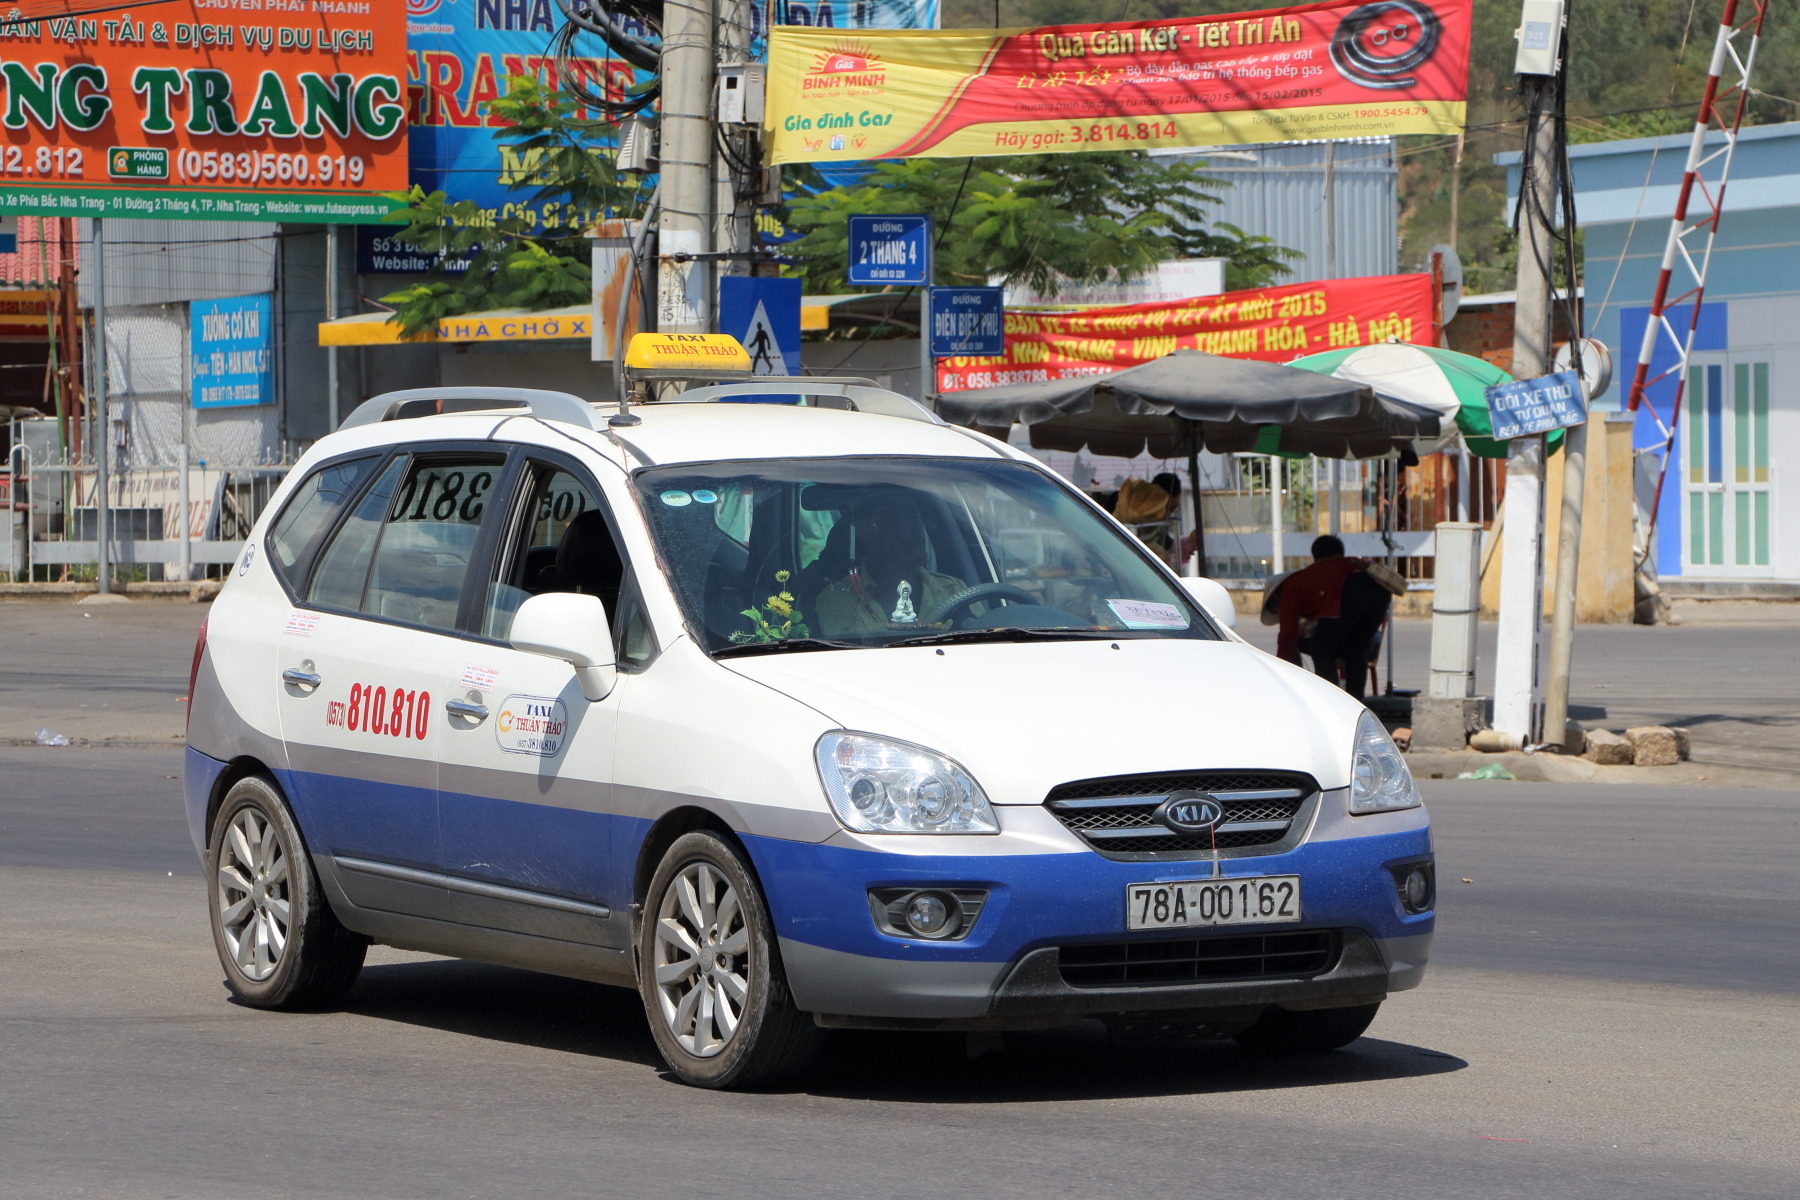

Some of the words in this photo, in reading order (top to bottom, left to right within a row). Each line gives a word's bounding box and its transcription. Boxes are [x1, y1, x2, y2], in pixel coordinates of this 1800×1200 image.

[312, 1, 370, 14] NHANH
[48, 16, 97, 43] VẬN
[103, 14, 145, 42] TẢI
[151, 22, 168, 42] &
[175, 23, 233, 48] DỊCH
[240, 26, 273, 50] VỤ
[279, 27, 312, 48] DU
[318, 29, 373, 52] LỊCH
[835, 60, 854, 70] Gas
[1302, 64, 1323, 76] gas
[845, 74, 885, 88] MINH
[131, 65, 404, 140] TRANG
[1256, 88, 1323, 100] 15/02/2015
[785, 115, 812, 131] Gia
[859, 110, 892, 127] Gas
[1319, 113, 1325, 121] &
[1354, 106, 1429, 119] 1900.5454.79
[995, 131, 1029, 149] Hãy
[1070, 121, 1178, 143] 3.814.814
[1282, 121, 1395, 136] www.gasbinhminh.com.vn
[177, 148, 364, 183] (0583)560.919
[6, 194, 17, 207] Xe
[20, 194, 38, 207] Phía
[41, 193, 57, 208] Bắc
[60, 196, 77, 208] Nha
[80, 196, 104, 211] Trang
[113, 197, 122, 209] 01
[155, 198, 161, 210] 2
[162, 198, 191, 213] Tháng
[217, 200, 234, 212] Nha
[235, 200, 259, 216] Trang
[266, 201, 302, 214] Website:
[304, 202, 389, 217] www.futaexpress.vn
[872, 221, 904, 233] ĐƯỜNG
[860, 240, 868, 265] 2
[870, 234, 906, 265] THÁNG
[909, 240, 917, 265] 4
[373, 255, 429, 270] Website:
[1278, 291, 1327, 318] 2015
[435, 320, 490, 338] NHÀ
[502, 318, 559, 336] CHỜ
[935, 308, 957, 340] ĐIỆN
[958, 308, 979, 336] BIÊN
[981, 306, 999, 336] PHỦ
[1053, 339, 1117, 363] TRANG
[1132, 335, 1177, 359] VINH
[1195, 328, 1258, 355] THANH
[1265, 320, 1308, 351] HÓA
[1329, 315, 1361, 347] HÀ
[652, 343, 700, 356] THUẬN
[701, 343, 738, 356] THẢO
[1522, 389, 1544, 406] XE
[326, 700, 346, 730] (0573)
[347, 682, 431, 741] 810.810
[527, 703, 552, 718] TAXI
[516, 716, 541, 737] THUẬN
[542, 718, 562, 736] THẢO
[1175, 804, 1214, 822] KIA
[1134, 881, 1295, 925] 78A-001.62
